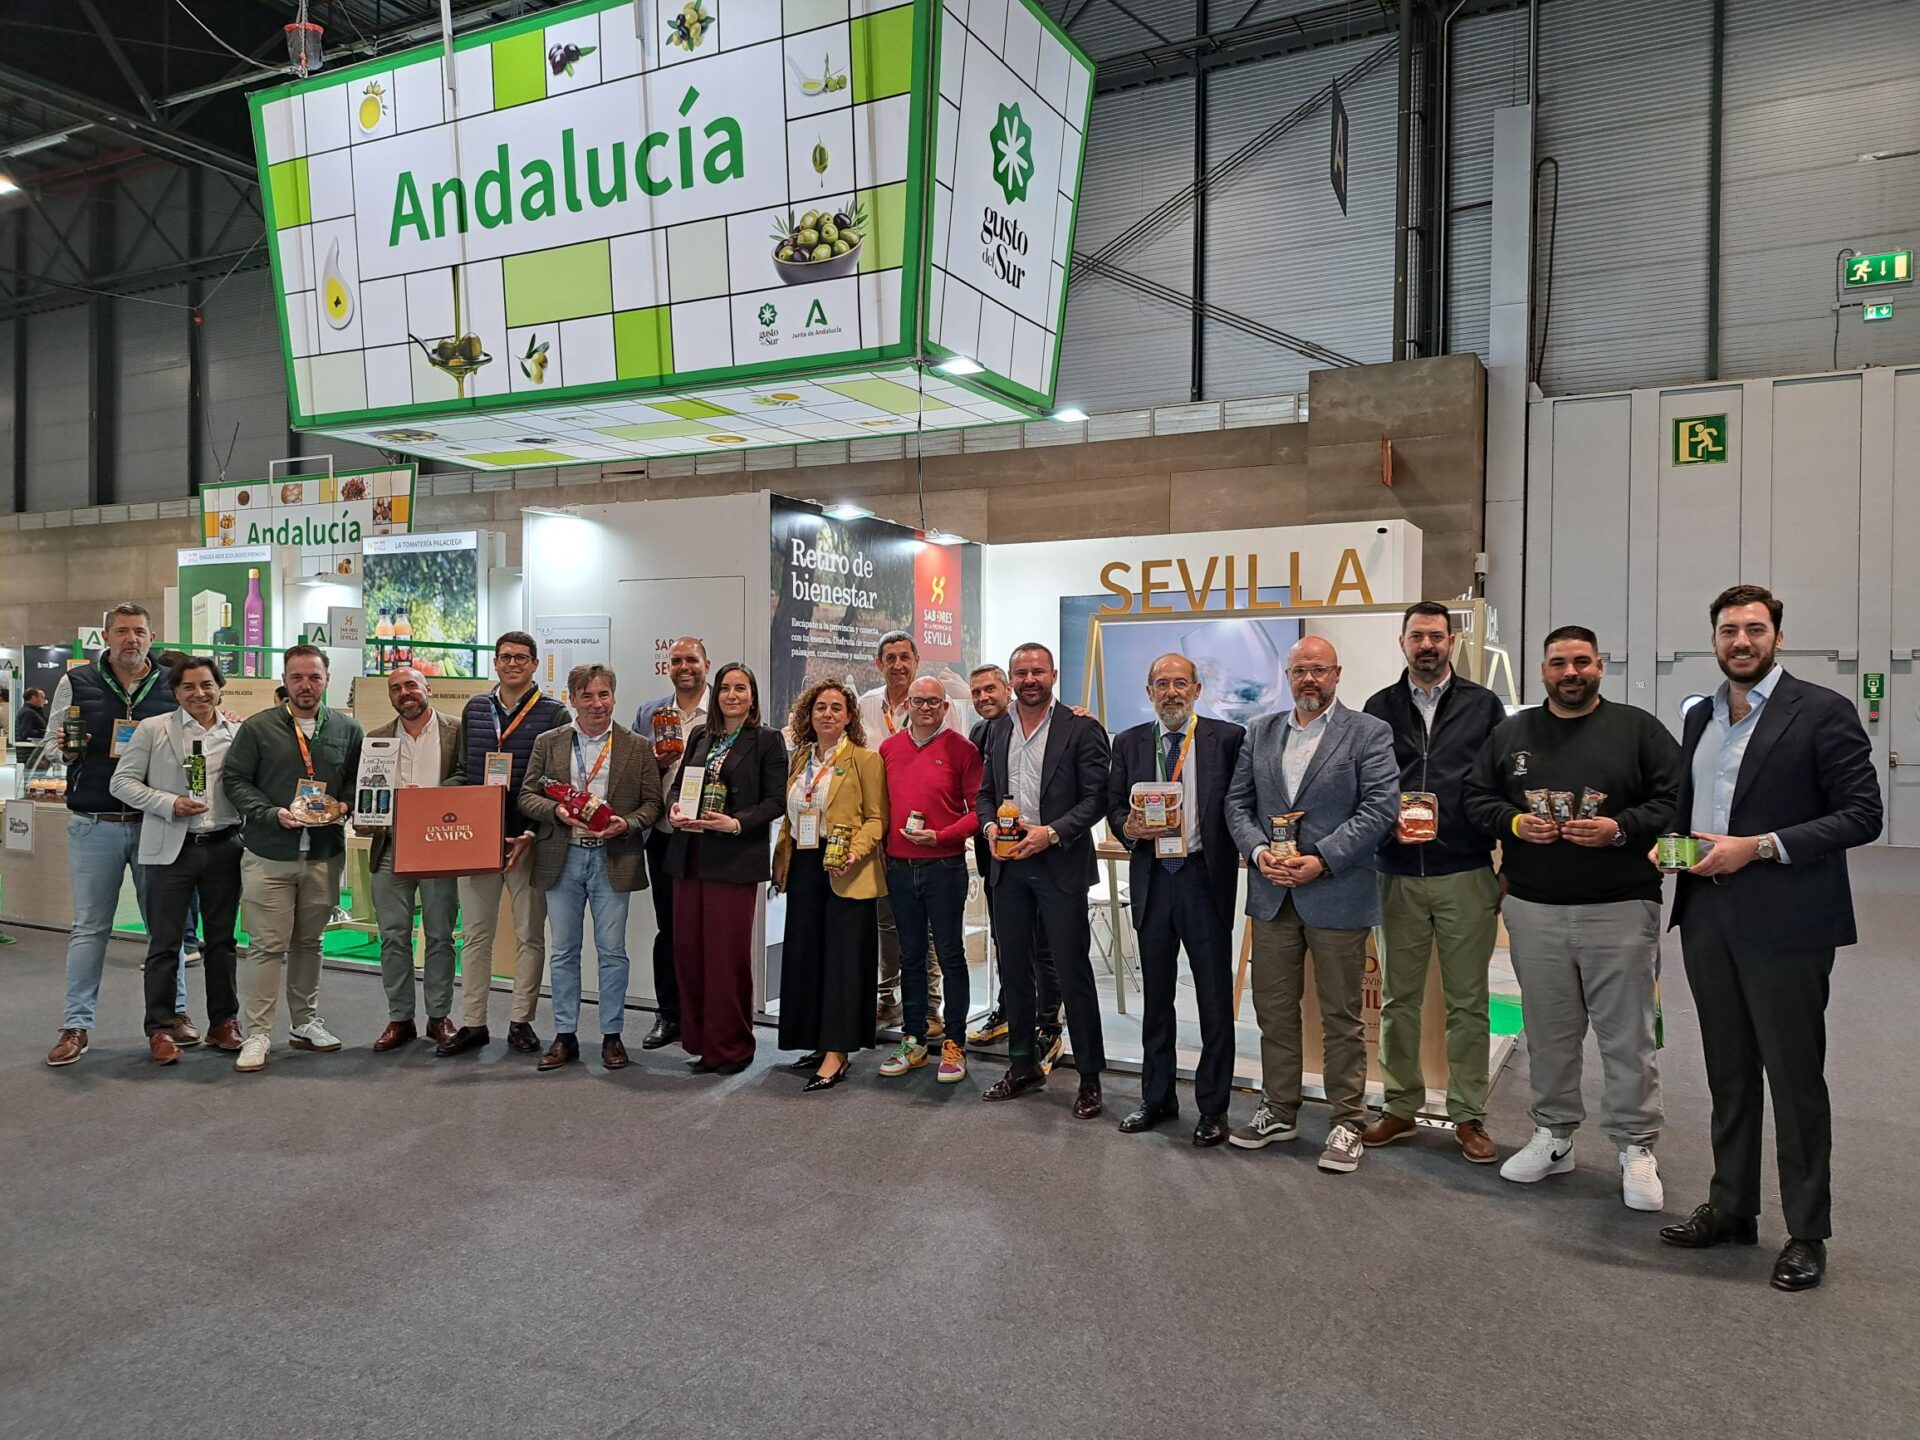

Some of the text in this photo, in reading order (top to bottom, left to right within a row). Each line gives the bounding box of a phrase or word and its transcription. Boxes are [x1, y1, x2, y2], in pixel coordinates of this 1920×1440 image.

[388, 86, 745, 248] Andalucía
[980, 206, 1028, 256] gusto
[982, 243, 1026, 289] del Sur
[759, 328, 779, 341] gusto
[815, 326, 842, 335] Andalucía
[247, 509, 361, 546] Andalucía
[790, 537, 874, 579] Retiro de
[791, 571, 878, 610] bienestar
[1099, 548, 1375, 616] SEVILLA
[924, 630, 953, 647] SEVILLA
[425, 830, 474, 842] CAMPO
[427, 825, 456, 833] LINAJE
